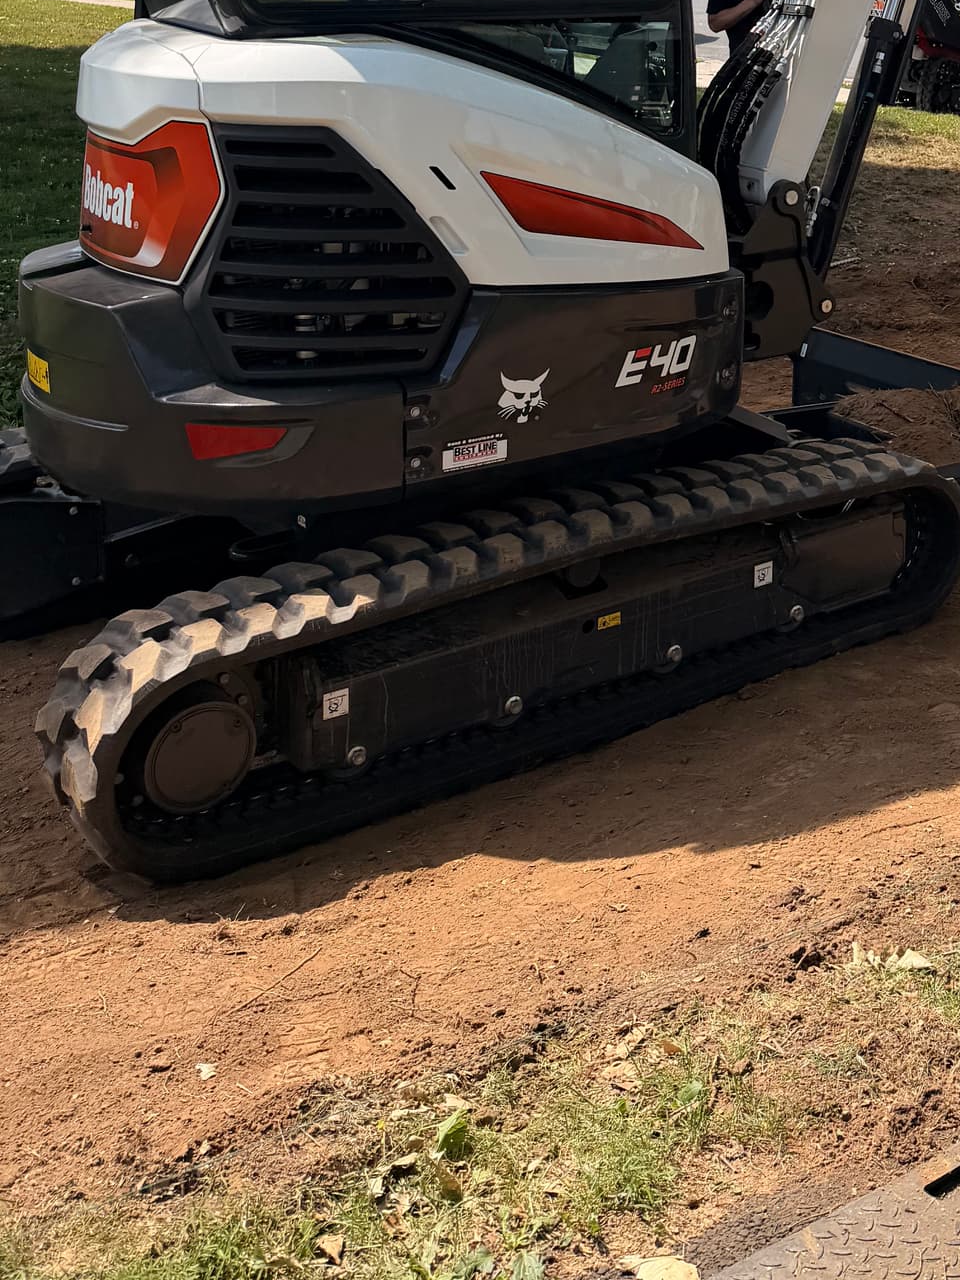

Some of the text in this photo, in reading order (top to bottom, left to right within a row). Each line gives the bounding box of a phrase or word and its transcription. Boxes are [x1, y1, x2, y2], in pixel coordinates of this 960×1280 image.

[84, 163, 135, 229] Bobcat
[615, 334, 697, 388] E40
[454, 441, 497, 457] BEST LINE
